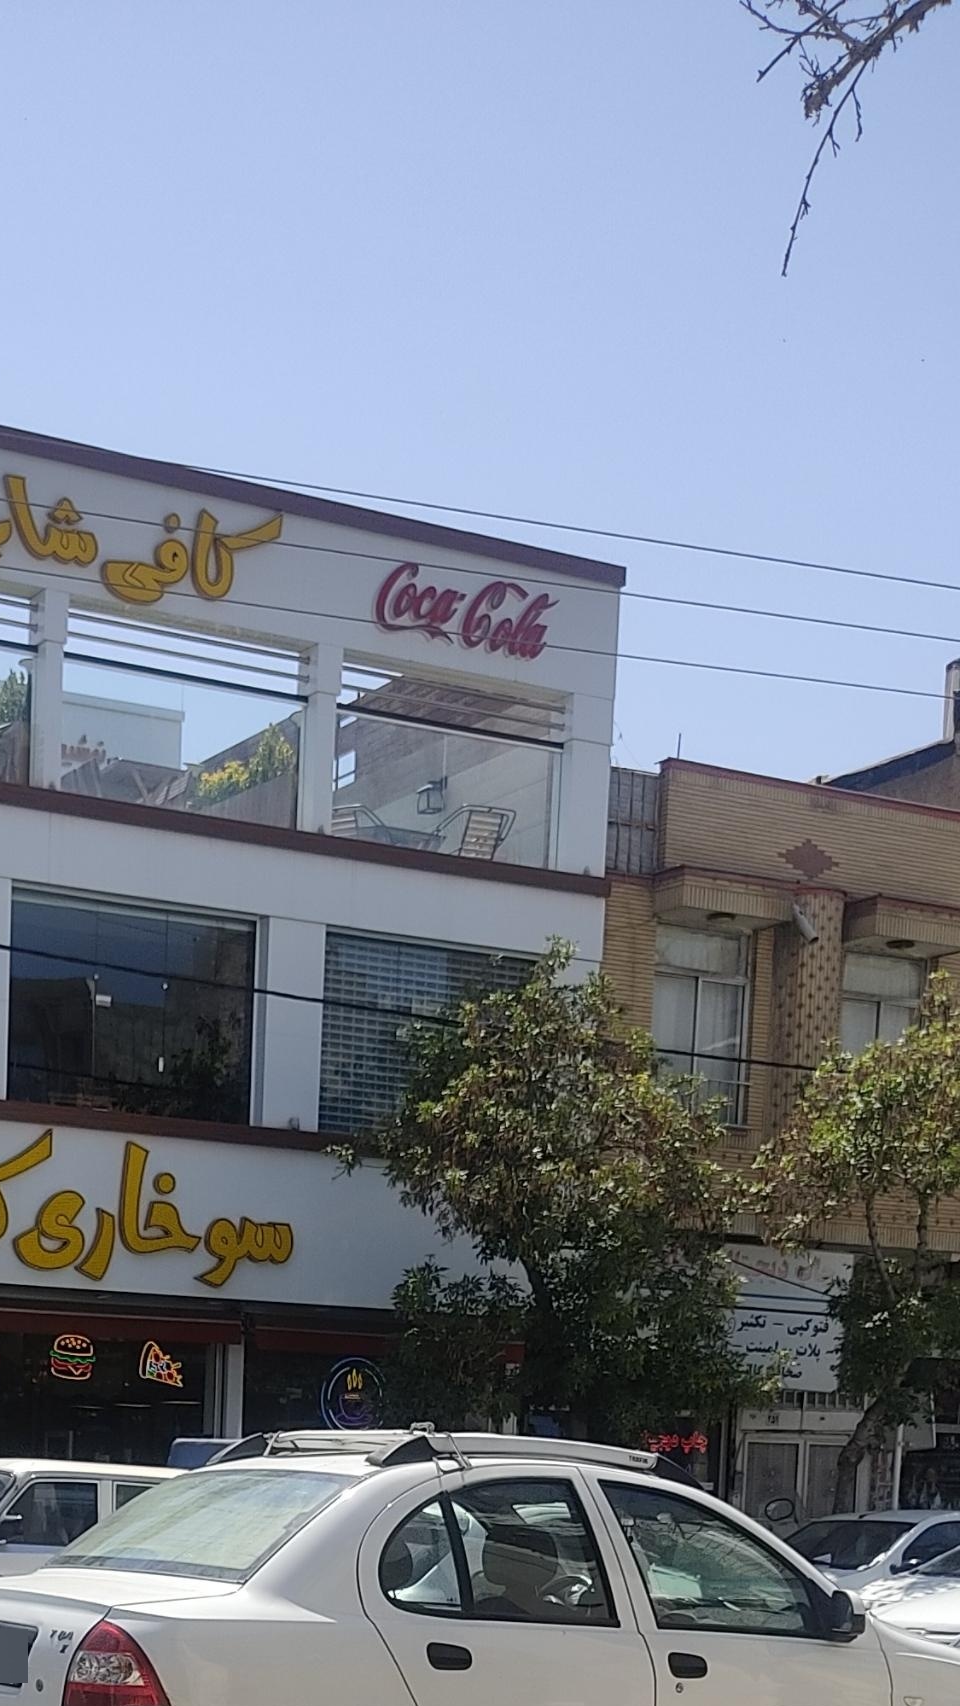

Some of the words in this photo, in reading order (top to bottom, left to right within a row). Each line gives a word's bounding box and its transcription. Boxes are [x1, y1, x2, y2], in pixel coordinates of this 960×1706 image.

[102, 508, 283, 605] کافی
[737, 1314, 767, 1332] تکثیر
[787, 1317, 829, 1337] فتوکپی
